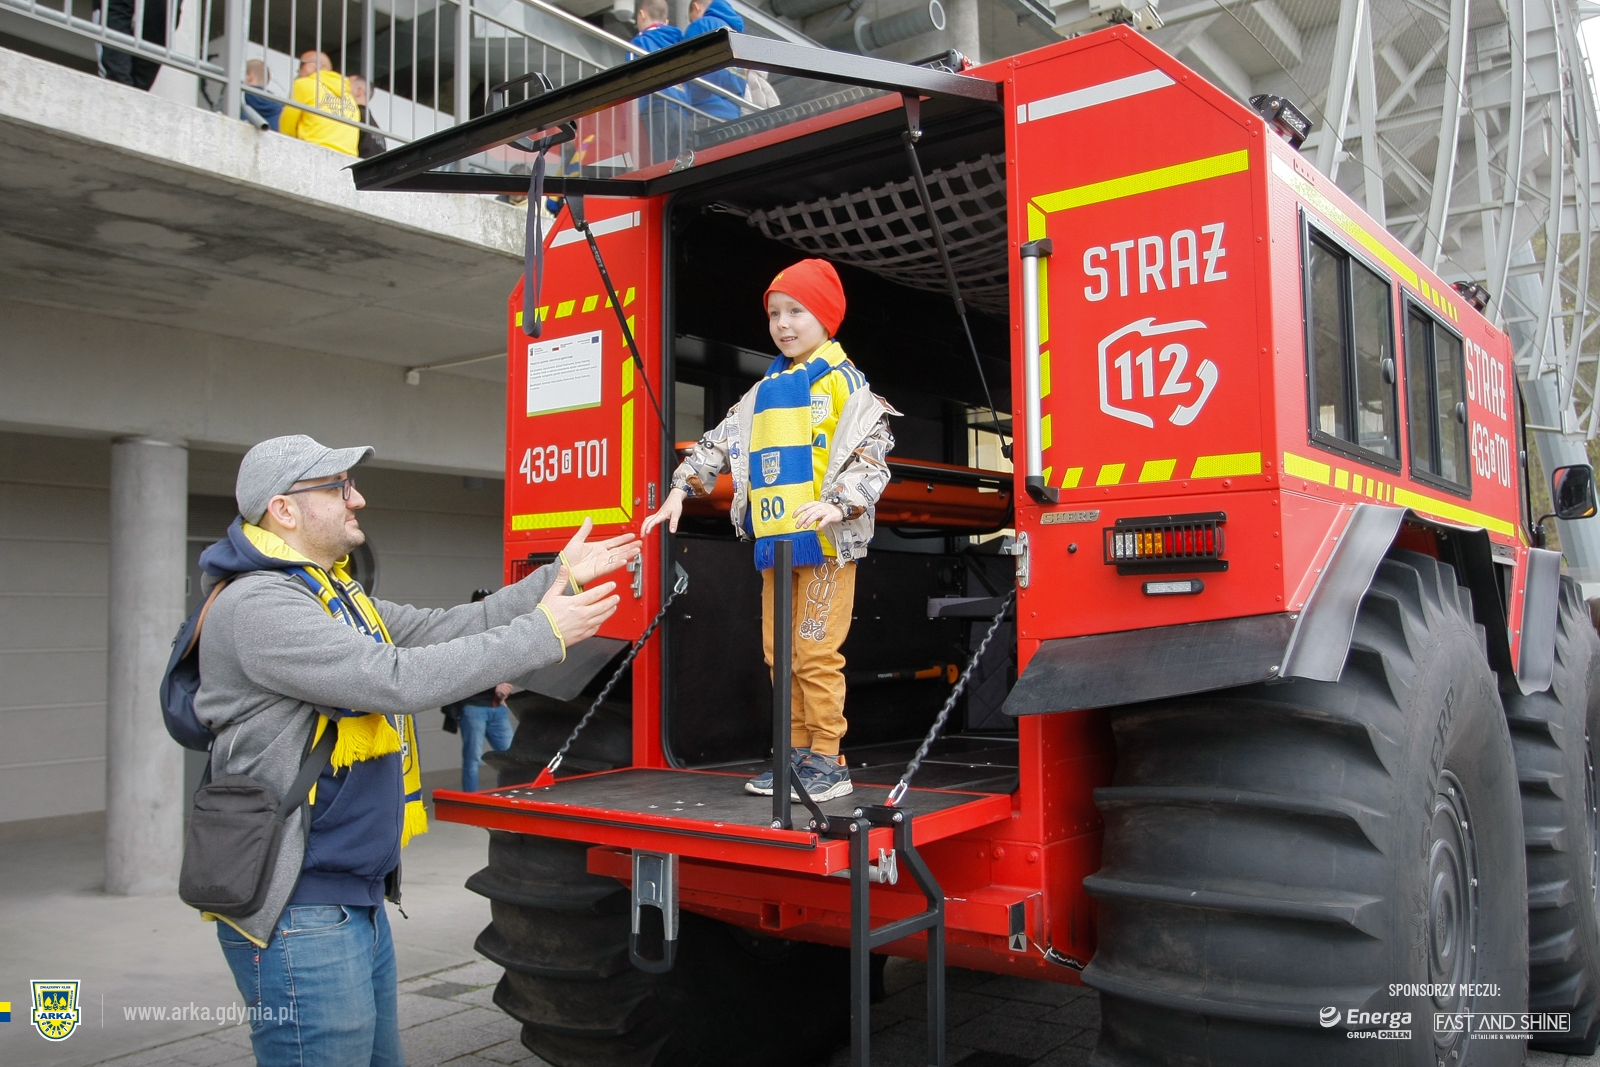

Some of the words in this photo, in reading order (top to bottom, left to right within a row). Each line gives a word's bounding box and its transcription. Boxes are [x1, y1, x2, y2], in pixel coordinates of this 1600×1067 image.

[1114, 343, 1192, 400] 112
[760, 496, 785, 521] 80
[1043, 511, 1097, 524] SHERP
